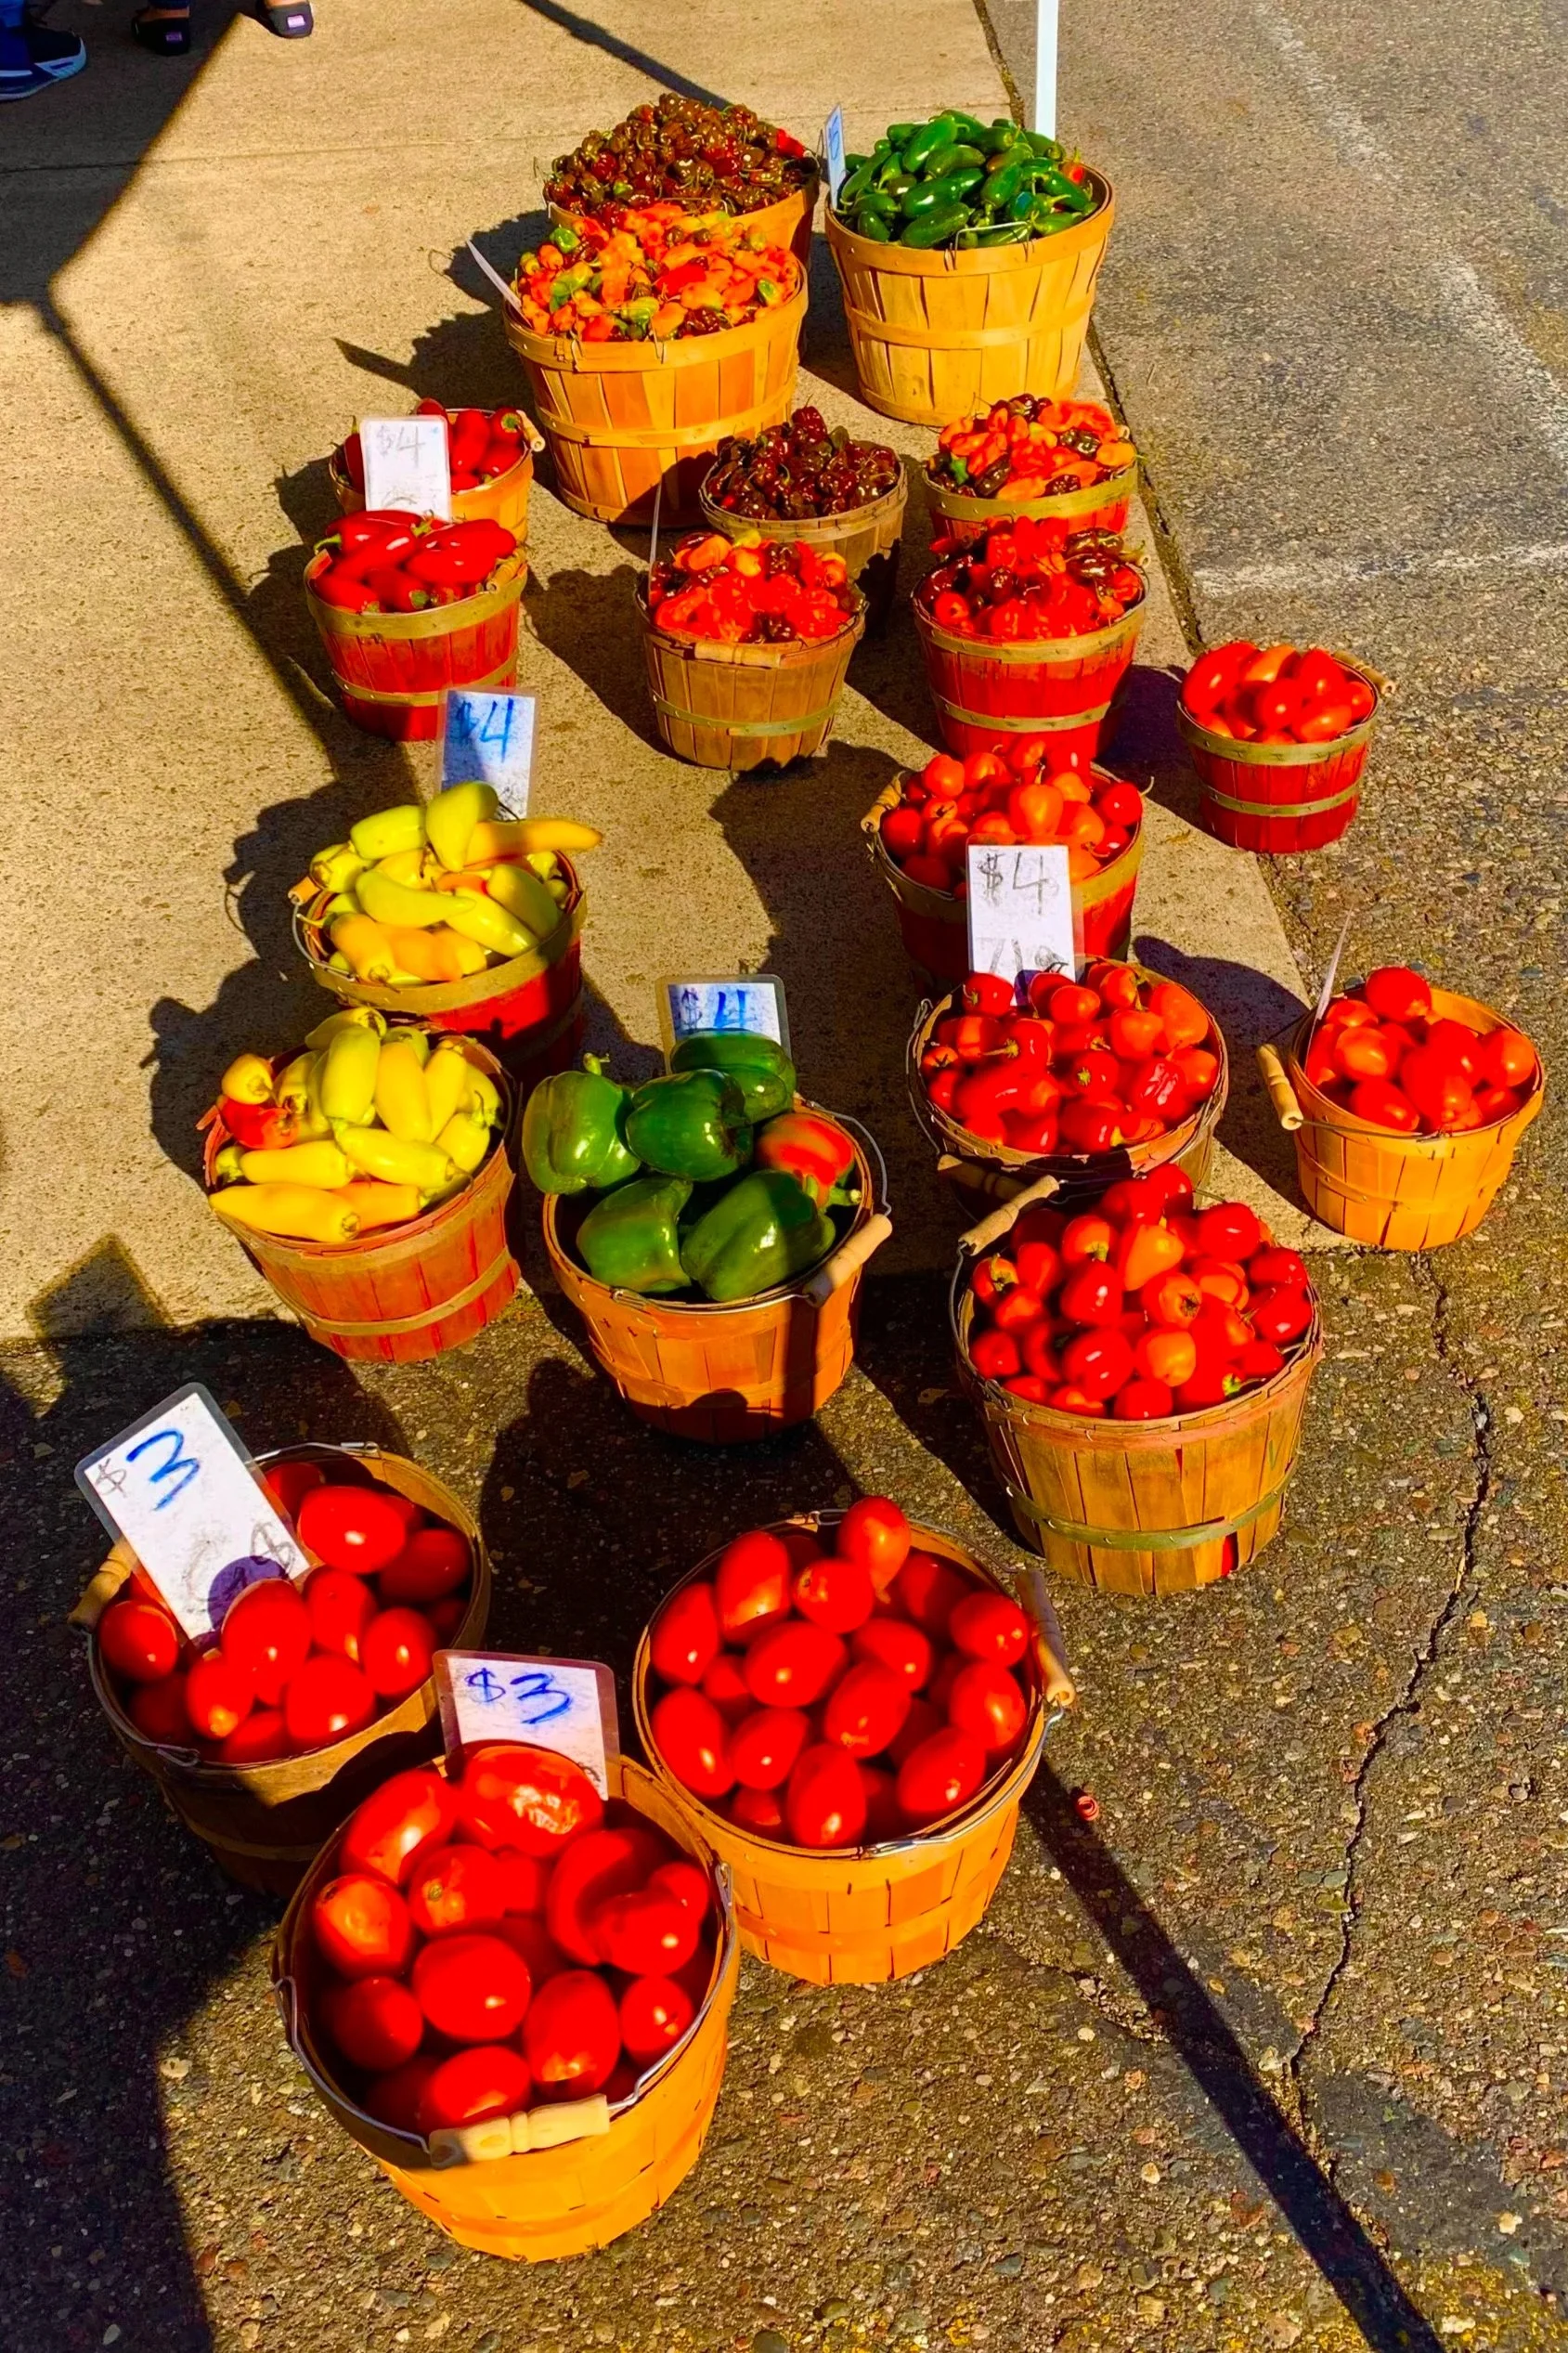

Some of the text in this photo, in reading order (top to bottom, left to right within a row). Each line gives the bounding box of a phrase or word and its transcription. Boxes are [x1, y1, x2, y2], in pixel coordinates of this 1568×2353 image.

[376, 424, 427, 469] $4
[450, 696, 514, 763] $4
[978, 851, 1050, 916] $4
[679, 987, 758, 1031] $4
[95, 1427, 201, 1512] $3
[464, 1667, 575, 1725] $3
